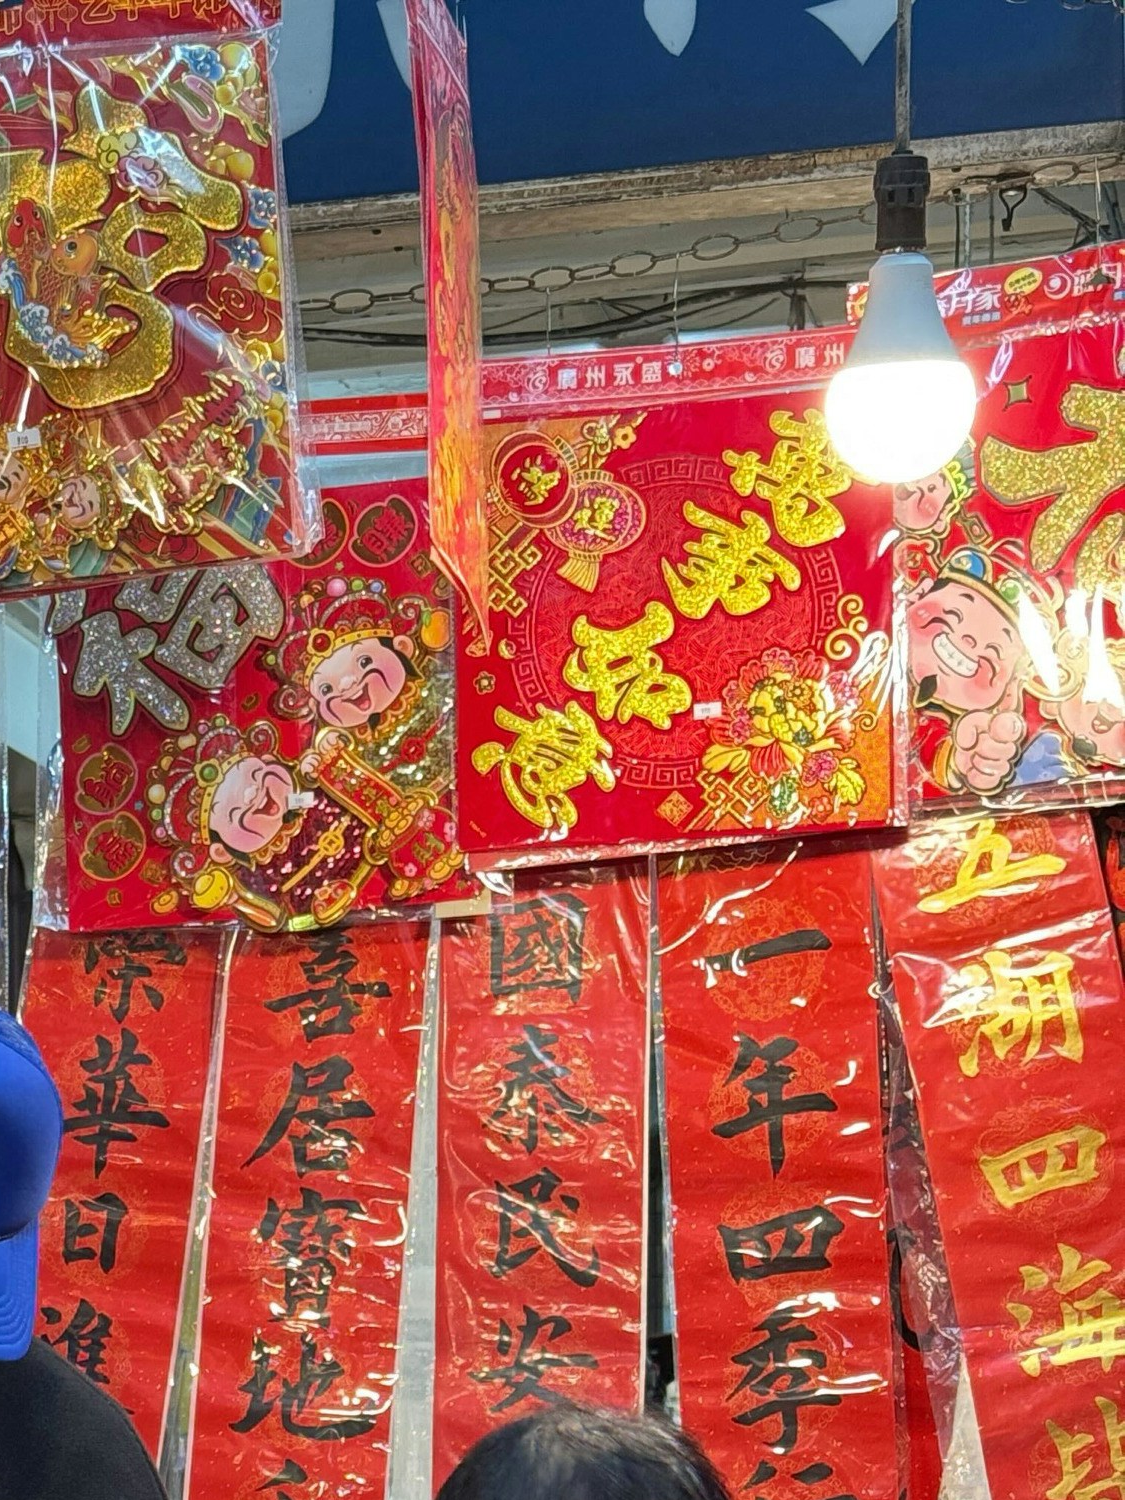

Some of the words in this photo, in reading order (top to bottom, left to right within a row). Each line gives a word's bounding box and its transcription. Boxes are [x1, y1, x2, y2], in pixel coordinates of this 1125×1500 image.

[557, 360, 663, 390] 廣州永盛
[472, 408, 855, 828] 萬事如意
[473, 892, 606, 1411] 國泰民安
